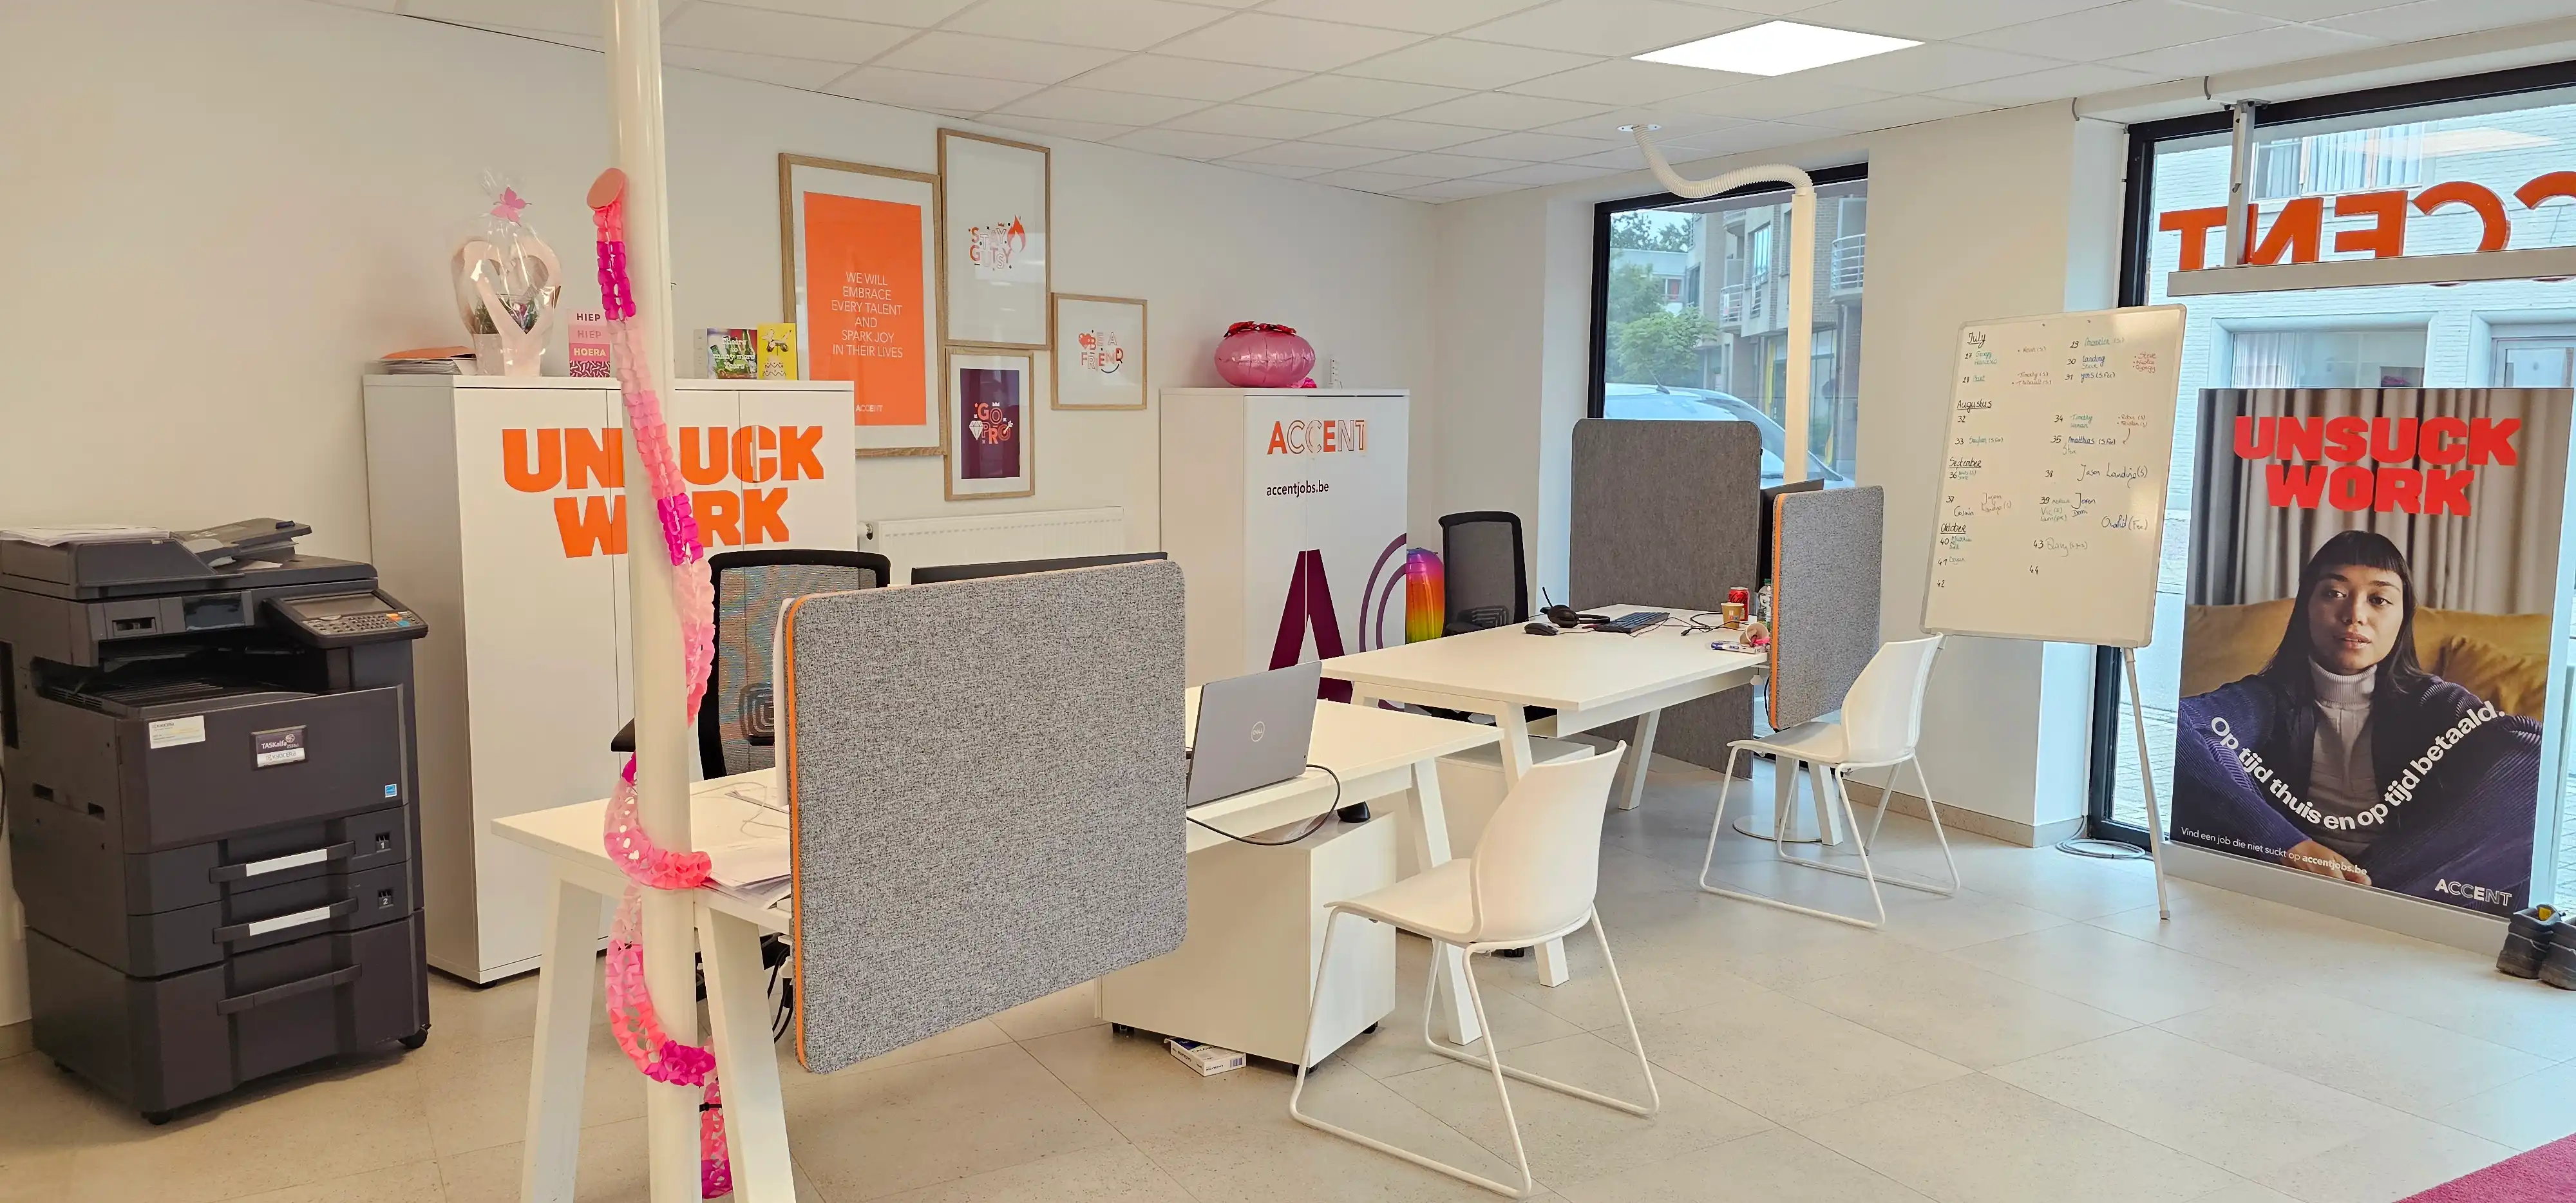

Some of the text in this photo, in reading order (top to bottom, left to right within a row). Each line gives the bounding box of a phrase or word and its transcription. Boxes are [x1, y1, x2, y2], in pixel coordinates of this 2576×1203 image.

[971, 227, 1007, 250] STAY
[846, 270, 888, 286] WE WILL
[843, 286, 891, 301] EMBRACE
[832, 299, 903, 316] EVERY TALENT
[576, 313, 601, 321] HIEP
[855, 316, 878, 328] AND
[578, 330, 601, 339] HIEP
[842, 329, 895, 343] SPARK JOY
[1090, 332, 1117, 350] BE A
[1967, 331, 1986, 348] July
[573, 348, 607, 356] HOERA
[833, 344, 903, 358] IN THEIR LIVES
[1081, 347, 1124, 372] FRIEND
[1956, 399, 1992, 413] Augustus
[978, 403, 1003, 424] GO
[2054, 414, 2063, 423] 34
[981, 422, 1011, 444] PRO
[1267, 420, 1365, 455] ACCENT
[2234, 416, 2521, 466] UNSUCK
[502, 425, 824, 493] UNUCK
[1949, 457, 1982, 471] September
[1949, 471, 1958, 479] 36
[2045, 469, 2054, 478] 38
[1267, 480, 1329, 498] accentjobs.be
[2265, 464, 2475, 516] WORK
[554, 488, 790, 558] WRK
[1940, 523, 1966, 535] Oktober
[1940, 538, 1950, 546] 40
[2033, 540, 2044, 549] 43
[2029, 565, 2040, 574] 44
[1937, 580, 1945, 588] 42
[261, 739, 287, 750] TASKalfa
[2211, 701, 2505, 829] Op tijd thuis en op tijd betaald.
[2181, 826, 2367, 875] Vind een job die niet suckt op accentjobs.be
[2435, 878, 2512, 906] ACCENT
[383, 897, 388, 905] 2
